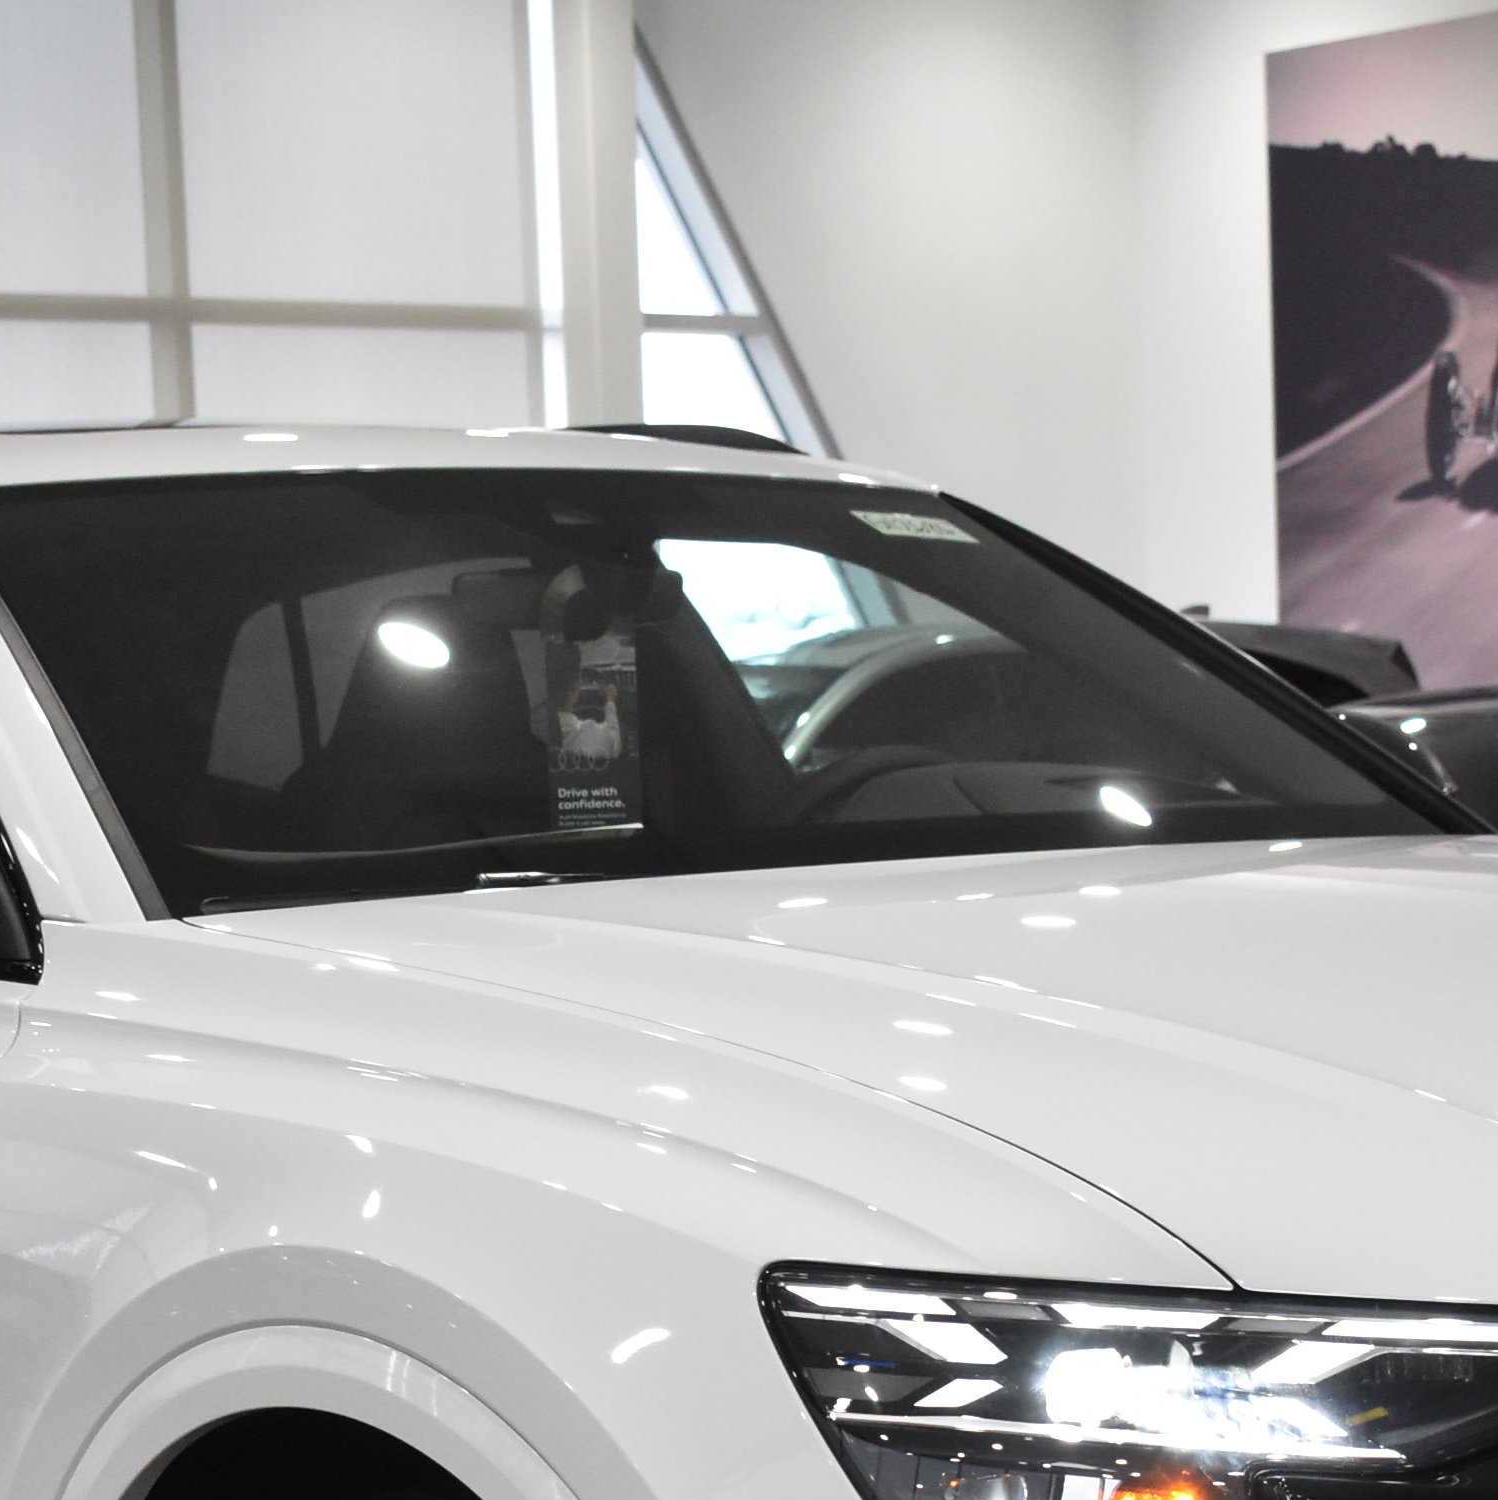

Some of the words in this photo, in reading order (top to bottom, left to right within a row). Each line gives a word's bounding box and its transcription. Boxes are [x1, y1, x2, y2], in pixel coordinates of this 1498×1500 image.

[558, 787, 588, 798] Drive
[591, 786, 618, 797] with
[558, 799, 626, 810] confidence.
